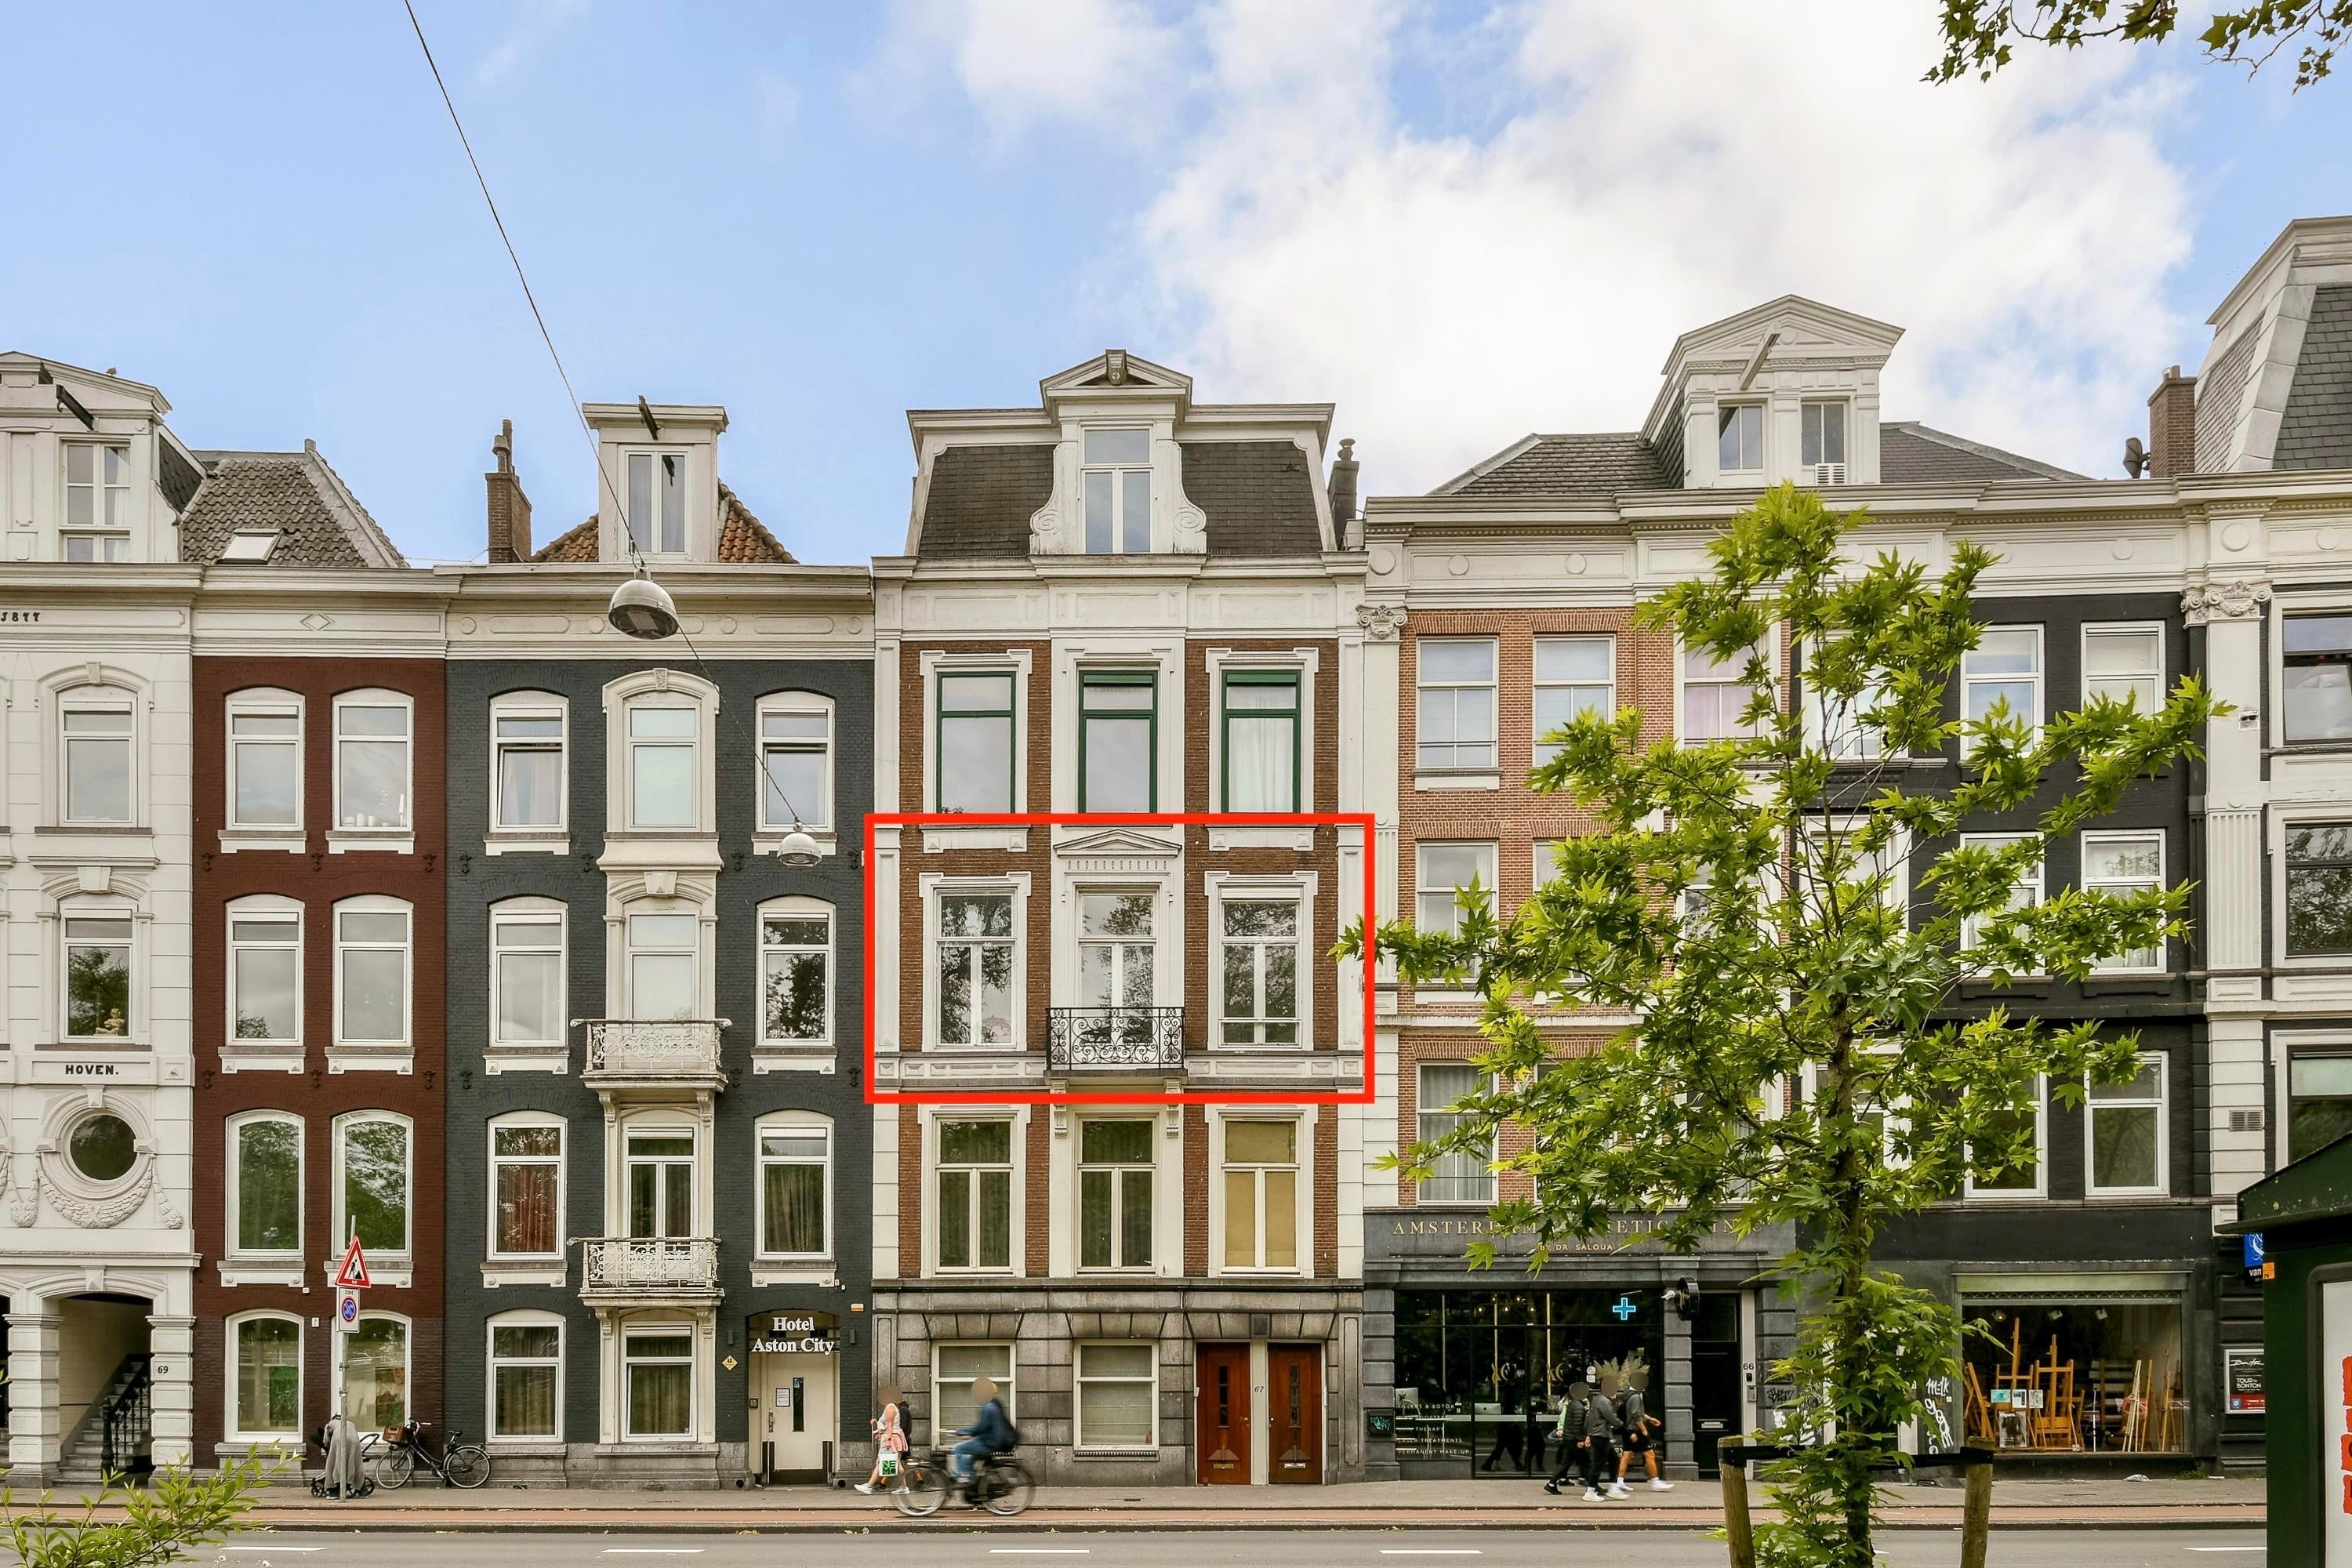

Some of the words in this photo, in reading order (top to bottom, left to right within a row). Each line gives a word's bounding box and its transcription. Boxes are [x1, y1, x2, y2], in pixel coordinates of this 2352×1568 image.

[65, 1065, 119, 1075] HOVEN.
[1392, 1221, 1538, 1235] AMSTERM
[772, 1317, 815, 1331] Hotel
[751, 1338, 797, 1352] Aston
[800, 1338, 835, 1356] City
